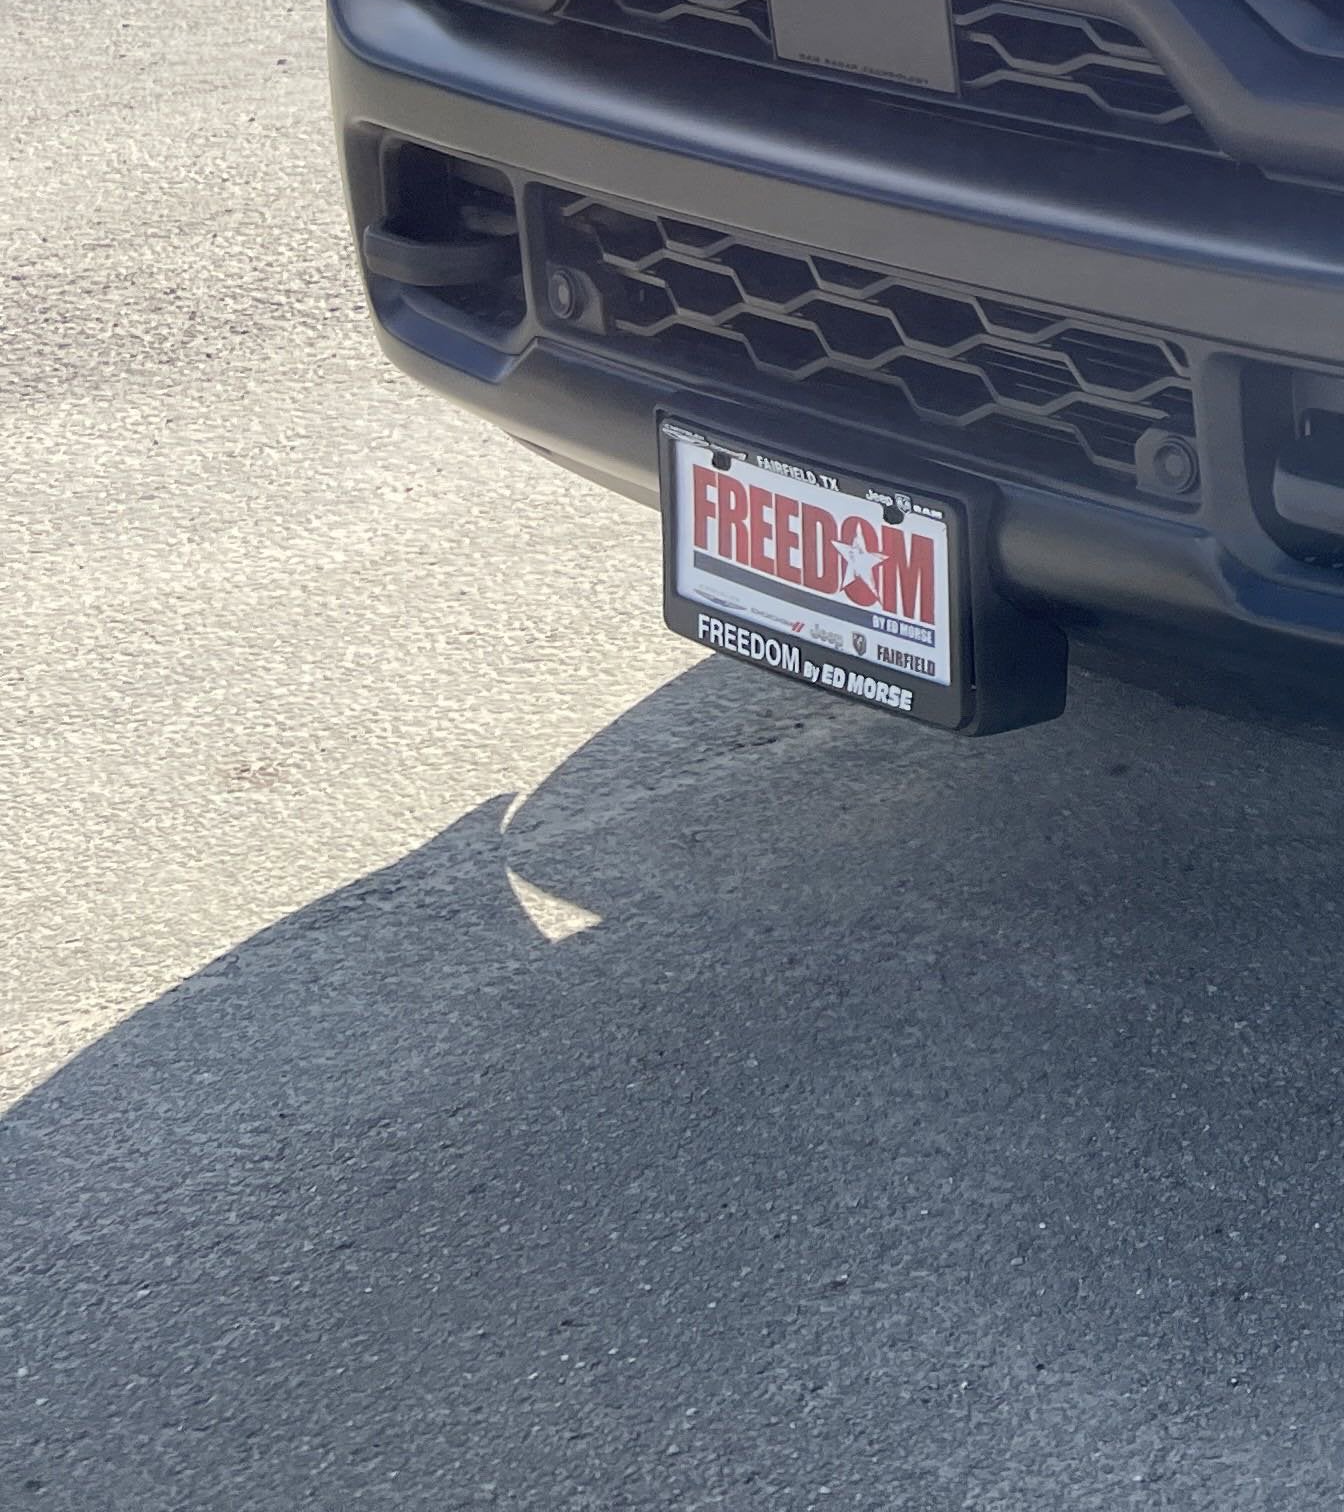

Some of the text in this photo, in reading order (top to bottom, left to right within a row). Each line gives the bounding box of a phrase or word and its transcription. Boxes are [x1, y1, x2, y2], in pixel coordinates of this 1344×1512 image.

[820, 474, 840, 492] TX
[865, 489, 893, 507] Jeep
[693, 464, 935, 625] FREEDOM
[872, 614, 934, 644] BY ED MORSE
[698, 613, 801, 674] FREEDOM
[821, 663, 846, 688] ED
[848, 672, 913, 711] MORSE
[877, 644, 935, 676] FAIRFIELD
